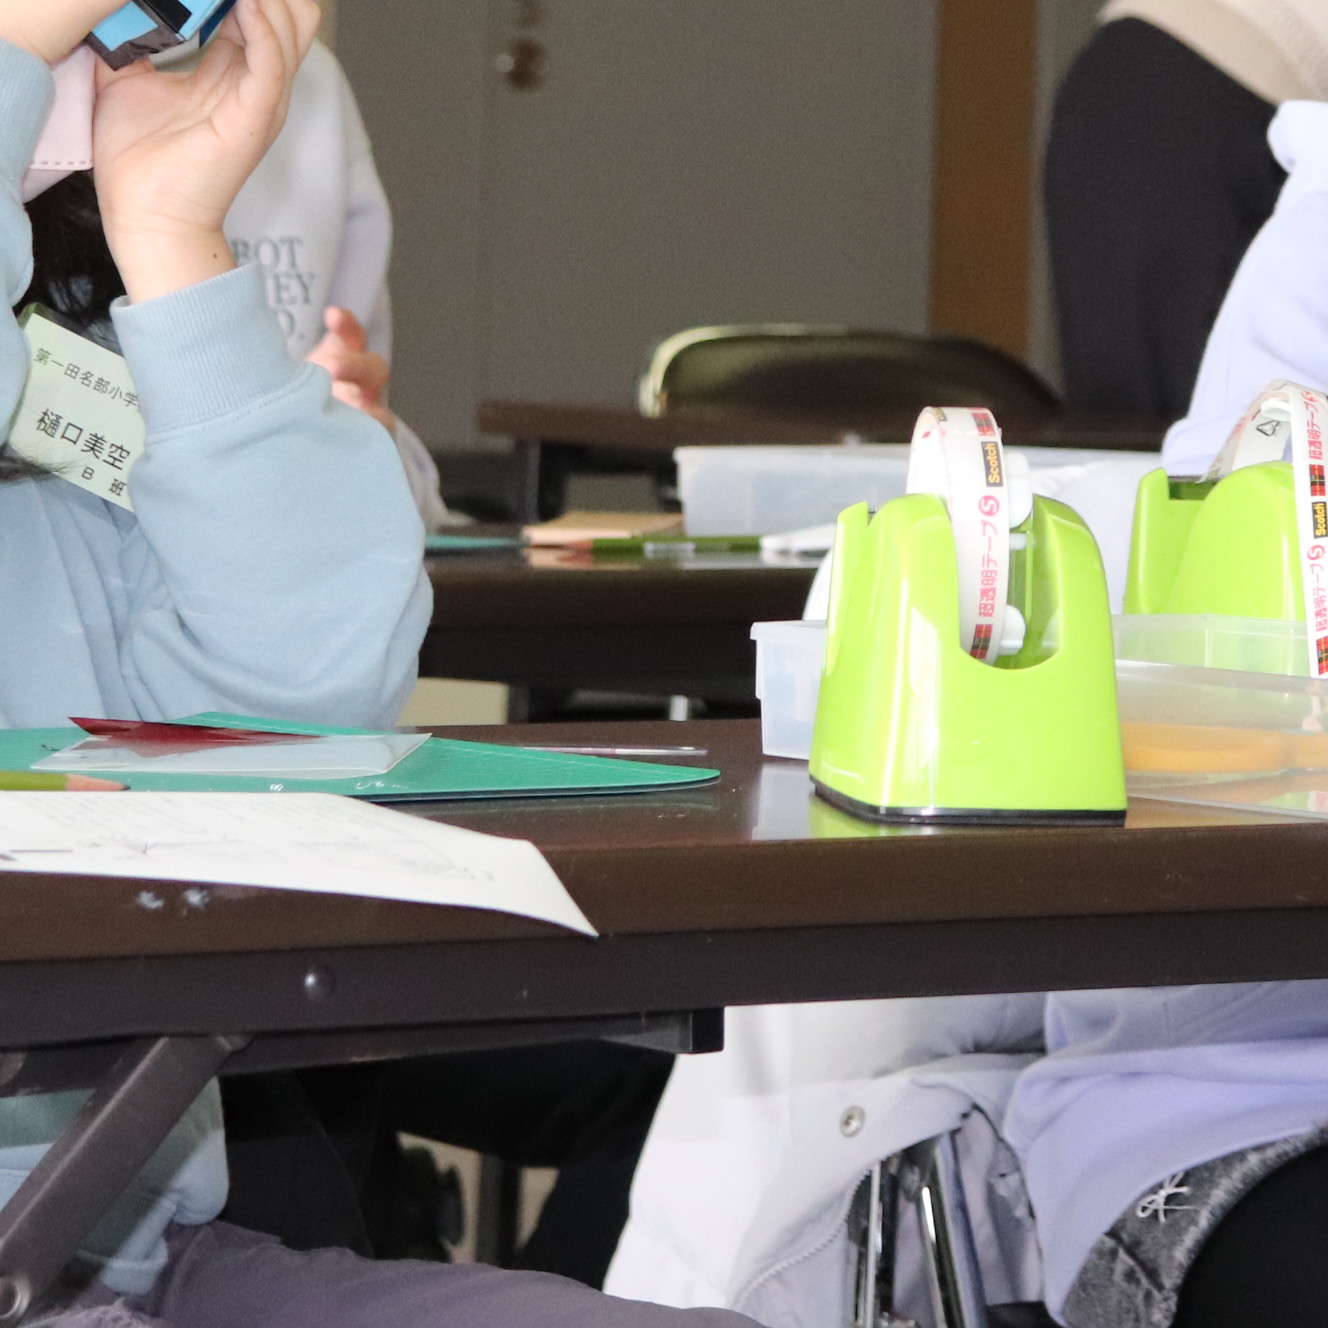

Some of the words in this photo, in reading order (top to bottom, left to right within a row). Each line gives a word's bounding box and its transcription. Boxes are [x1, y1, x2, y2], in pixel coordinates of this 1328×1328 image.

[36, 408, 130, 470] 樋口美空
[984, 443, 1000, 484] Scotch
[1314, 502, 1327, 537] Scotch
